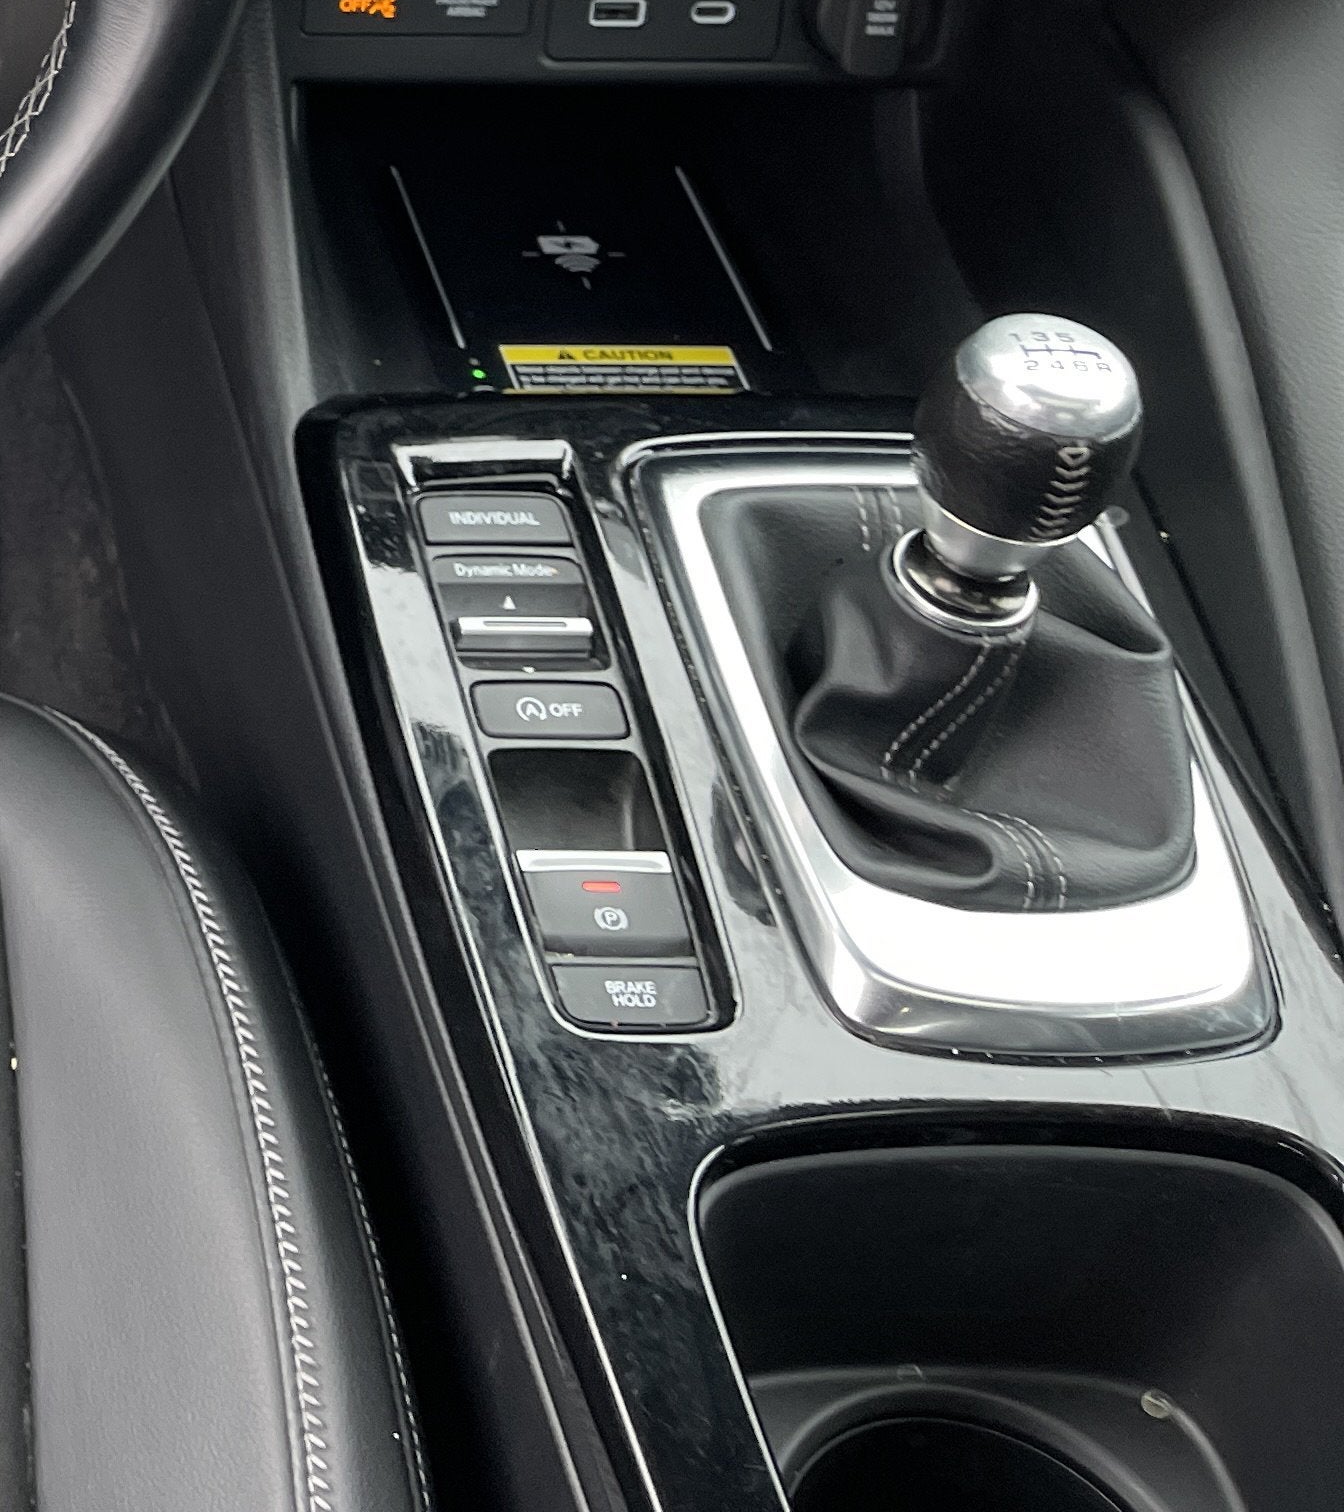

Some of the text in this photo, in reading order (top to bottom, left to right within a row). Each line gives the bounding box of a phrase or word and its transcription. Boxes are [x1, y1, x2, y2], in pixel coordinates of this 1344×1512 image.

[583, 349, 674, 361] CAUTION
[448, 511, 542, 526] INDIVIDUAL
[453, 563, 554, 578] Dynamic Mode
[549, 703, 583, 717] OFF
[605, 980, 657, 995] BRAKE
[612, 993, 657, 1007] HOLD
